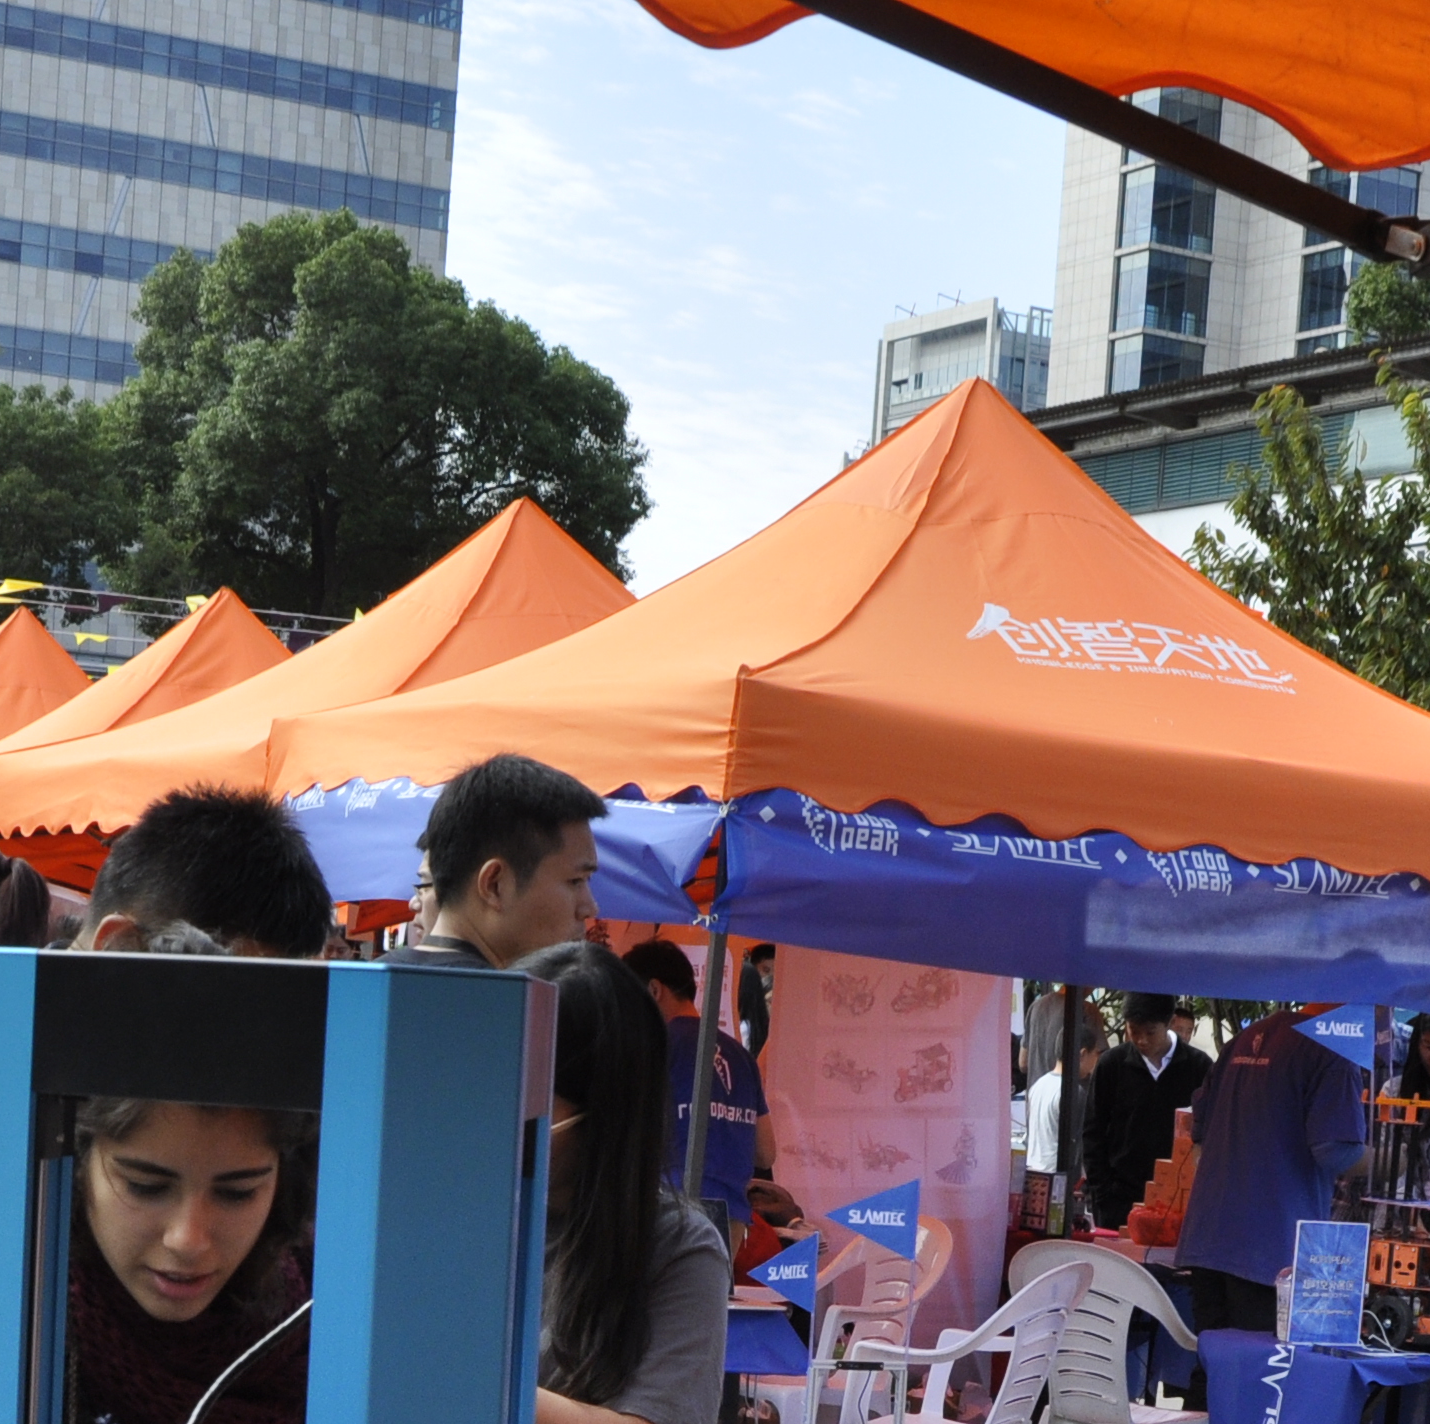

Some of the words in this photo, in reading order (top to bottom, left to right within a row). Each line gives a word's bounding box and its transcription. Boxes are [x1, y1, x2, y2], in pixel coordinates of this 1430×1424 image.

[1180, 849, 1230, 872] robo
[1184, 868, 1233, 896] peak
[1314, 1020, 1365, 1038] SLAMTEC
[848, 1208, 906, 1227] SLAMTEC
[767, 1263, 809, 1281] SLAMTEC
